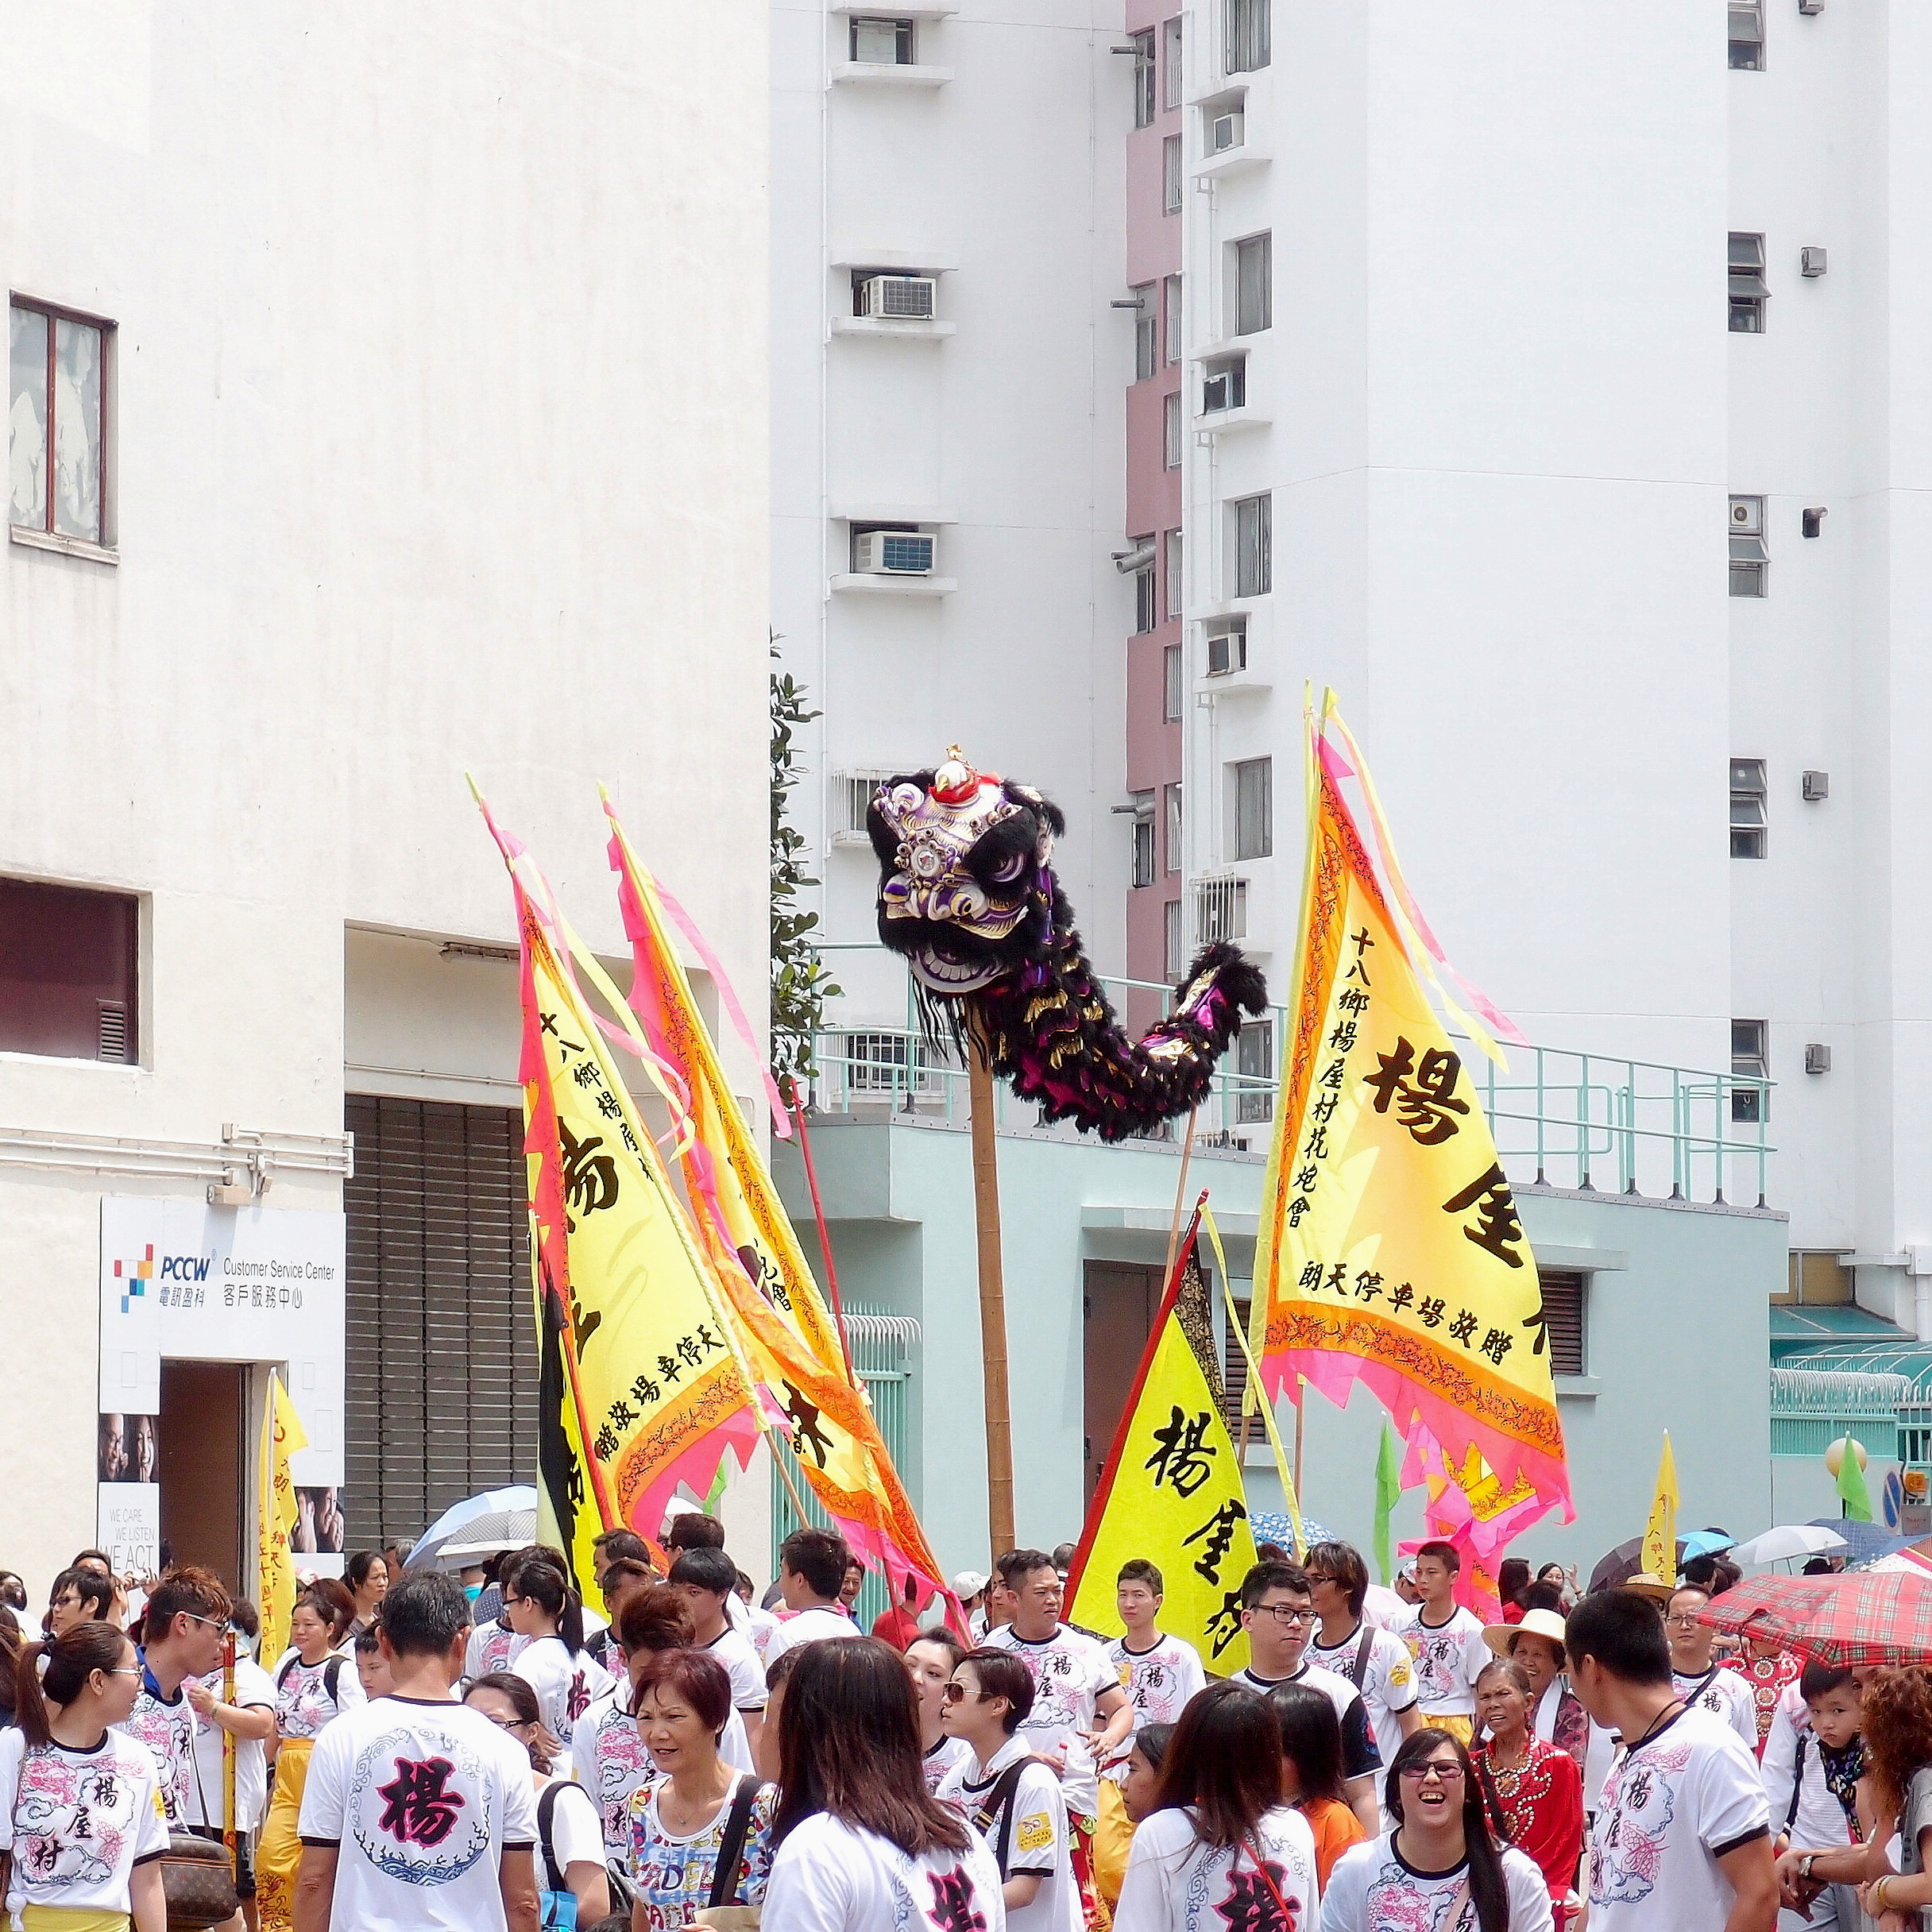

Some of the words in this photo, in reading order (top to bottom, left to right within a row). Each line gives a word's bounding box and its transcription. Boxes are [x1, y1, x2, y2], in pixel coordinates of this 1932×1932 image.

[160, 1256, 211, 1281] PCCW
[223, 1257, 268, 1278] Customer
[270, 1260, 303, 1280] Service
[305, 1262, 335, 1281] Center
[159, 1286, 205, 1308] 電訊盈科
[223, 1284, 303, 1309] 客戶服務中心
[110, 1509, 121, 1522] WE
[122, 1509, 142, 1523] CARE
[115, 1527, 127, 1540] WE
[129, 1527, 155, 1541] LISTEN
[125, 1544, 154, 1571] ACT
[377, 1756, 466, 1849] 楊
